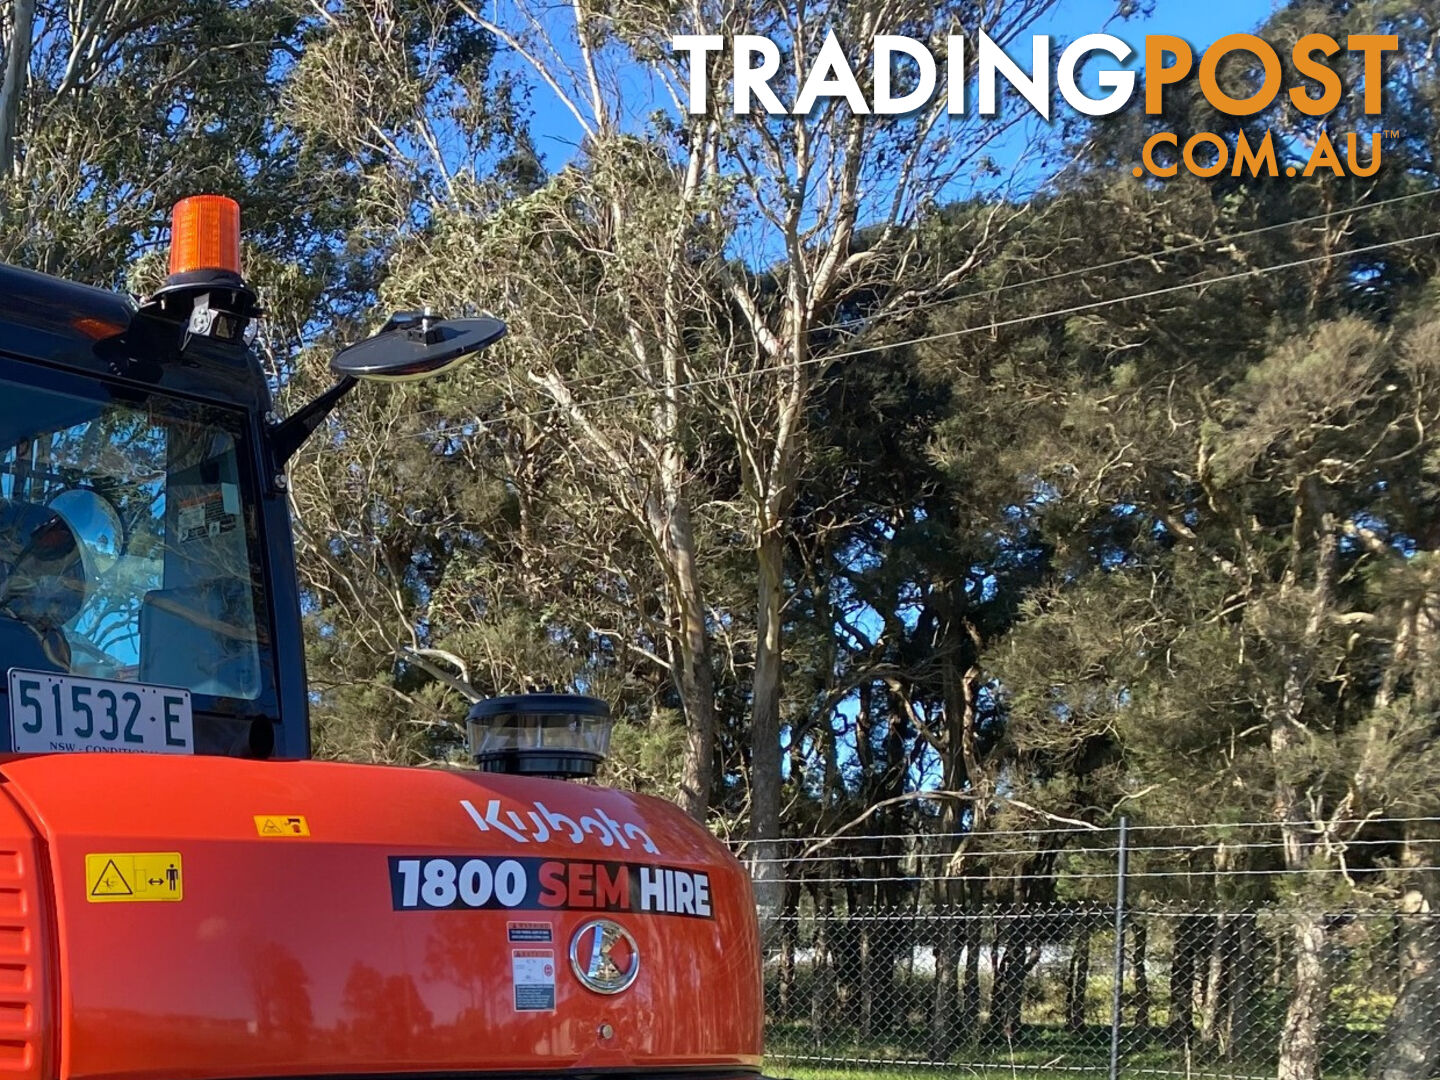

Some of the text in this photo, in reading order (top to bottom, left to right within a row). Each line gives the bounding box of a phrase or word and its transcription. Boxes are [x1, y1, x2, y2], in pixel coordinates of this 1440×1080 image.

[49, 741, 75, 752] NSW
[461, 800, 660, 855] Kubota
[398, 859, 711, 916] 1800 SEM HIRE
